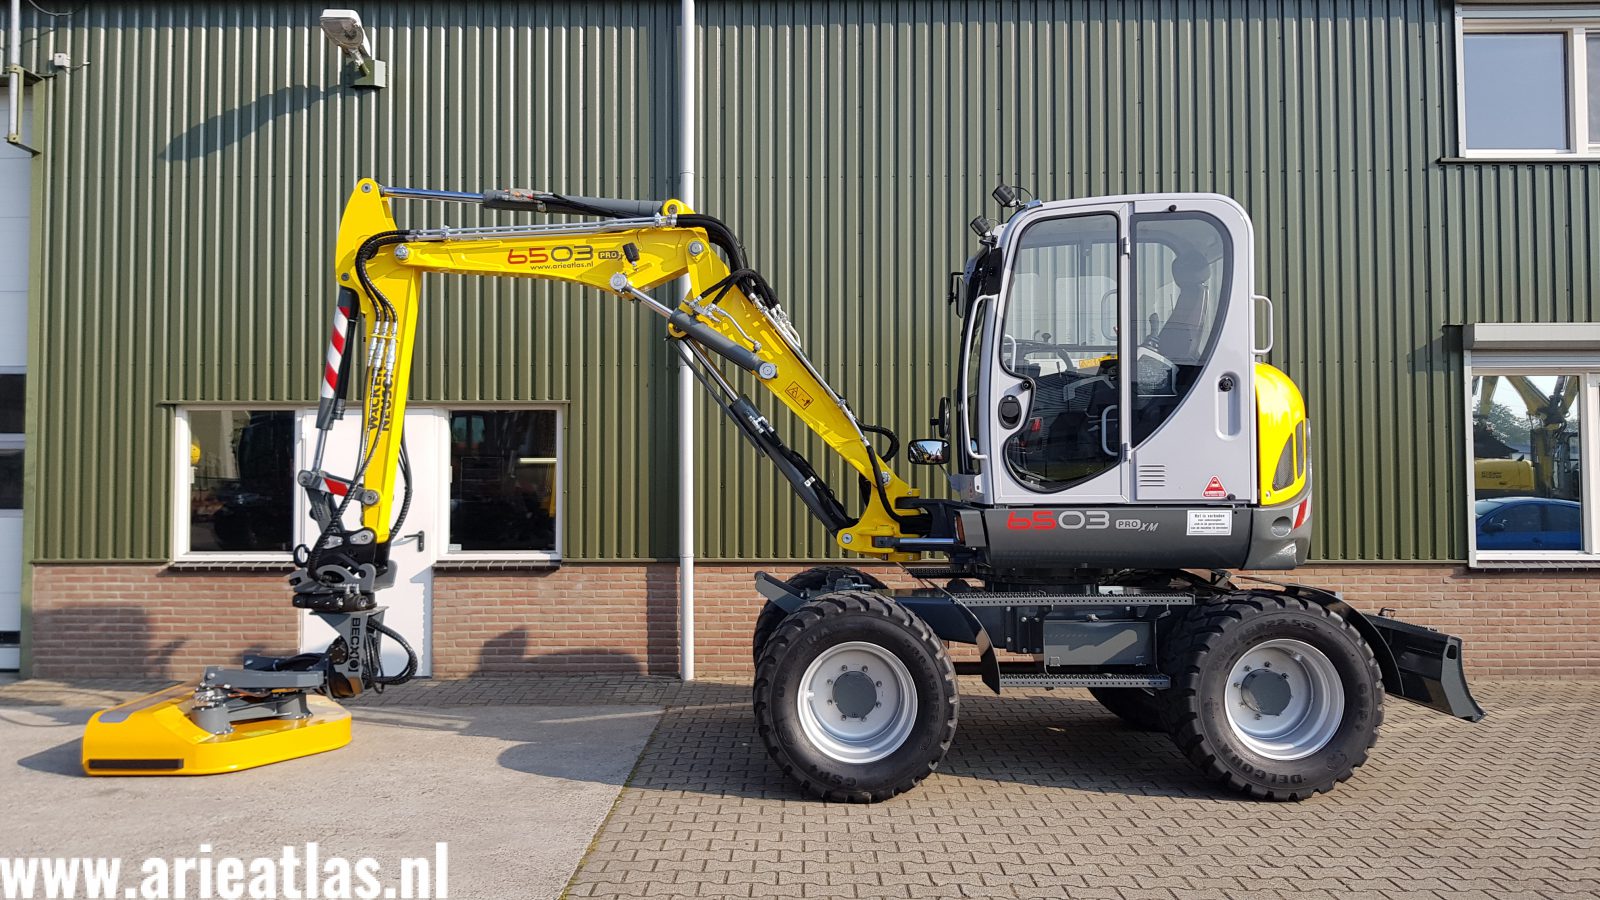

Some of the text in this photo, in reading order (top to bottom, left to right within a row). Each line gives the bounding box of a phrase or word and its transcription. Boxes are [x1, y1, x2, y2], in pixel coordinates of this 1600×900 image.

[507, 245, 594, 265] 6503
[530, 261, 594, 271] www.arieatlas.nl
[1007, 510, 1159, 532] 6503 PRO XM
